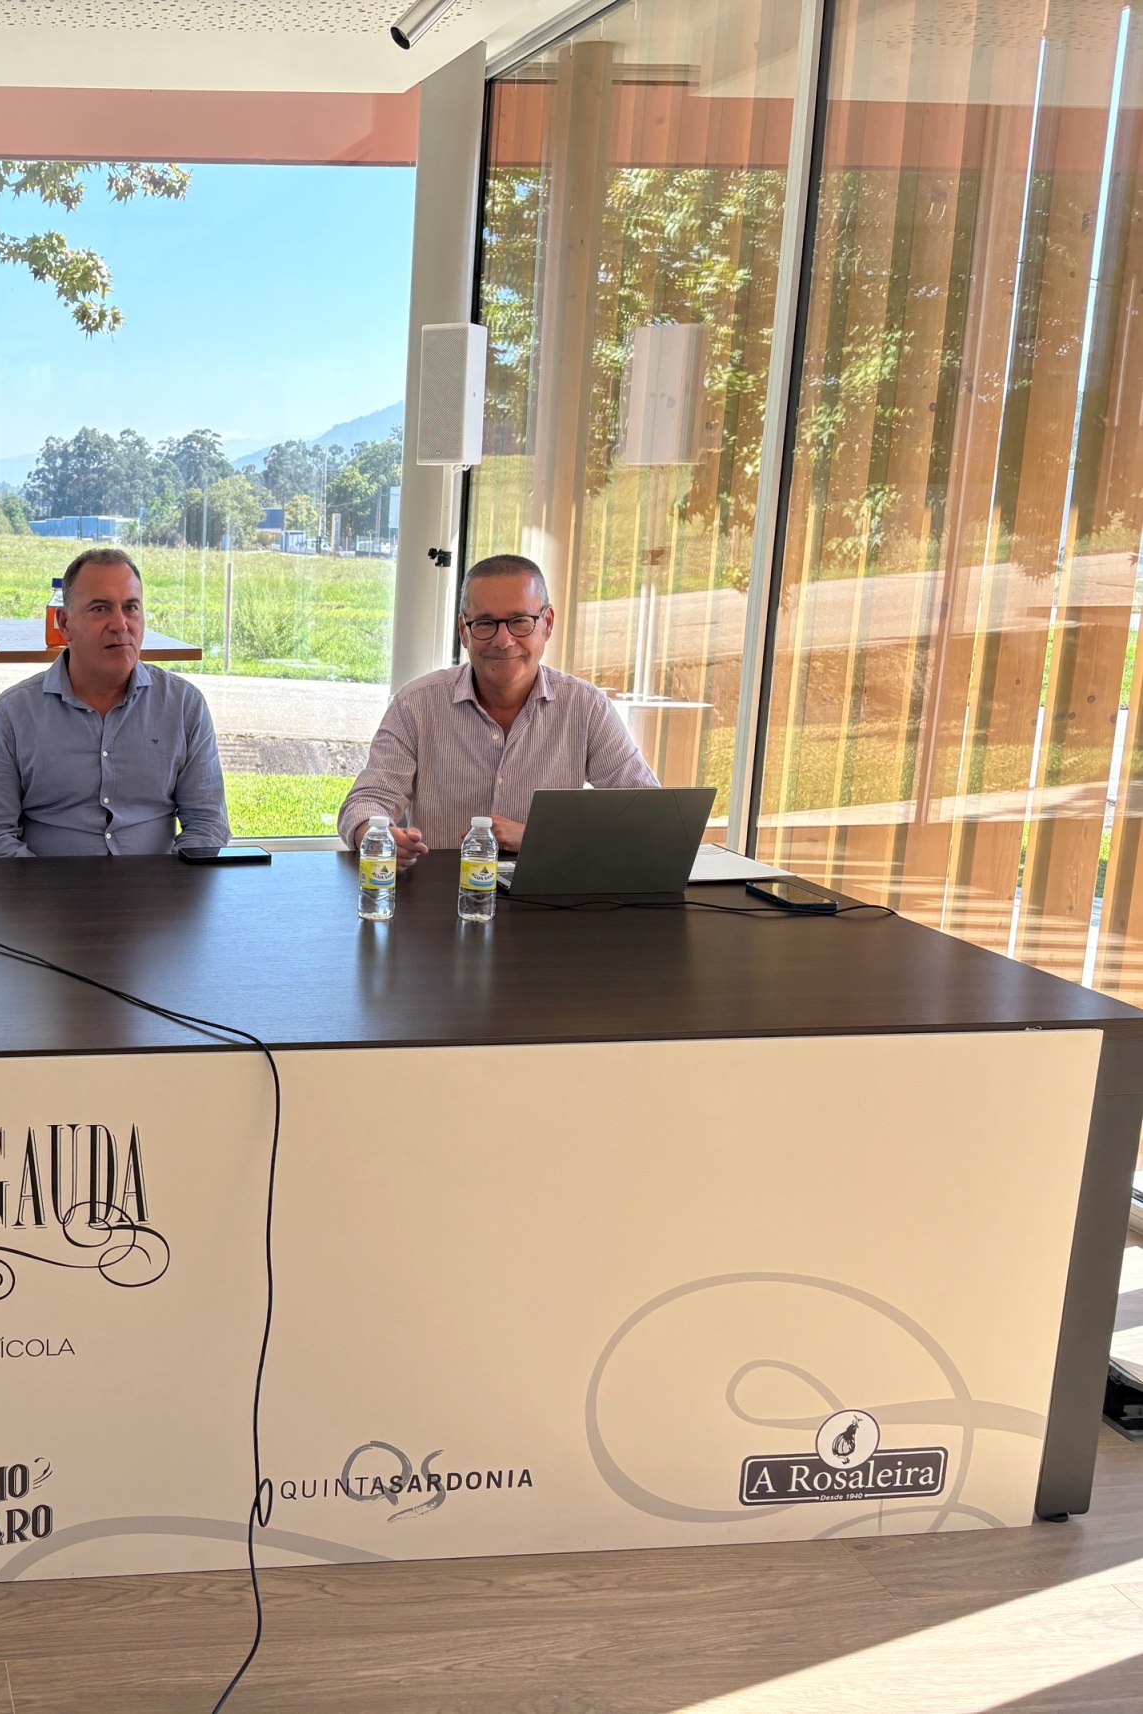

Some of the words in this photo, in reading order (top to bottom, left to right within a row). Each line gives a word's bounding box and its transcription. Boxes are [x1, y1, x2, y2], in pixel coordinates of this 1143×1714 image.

[749, 1466, 777, 1494] A
[787, 1461, 935, 1492] Rosaleira
[819, 1494, 844, 1502] Desde
[846, 1492, 863, 1500] 1940
